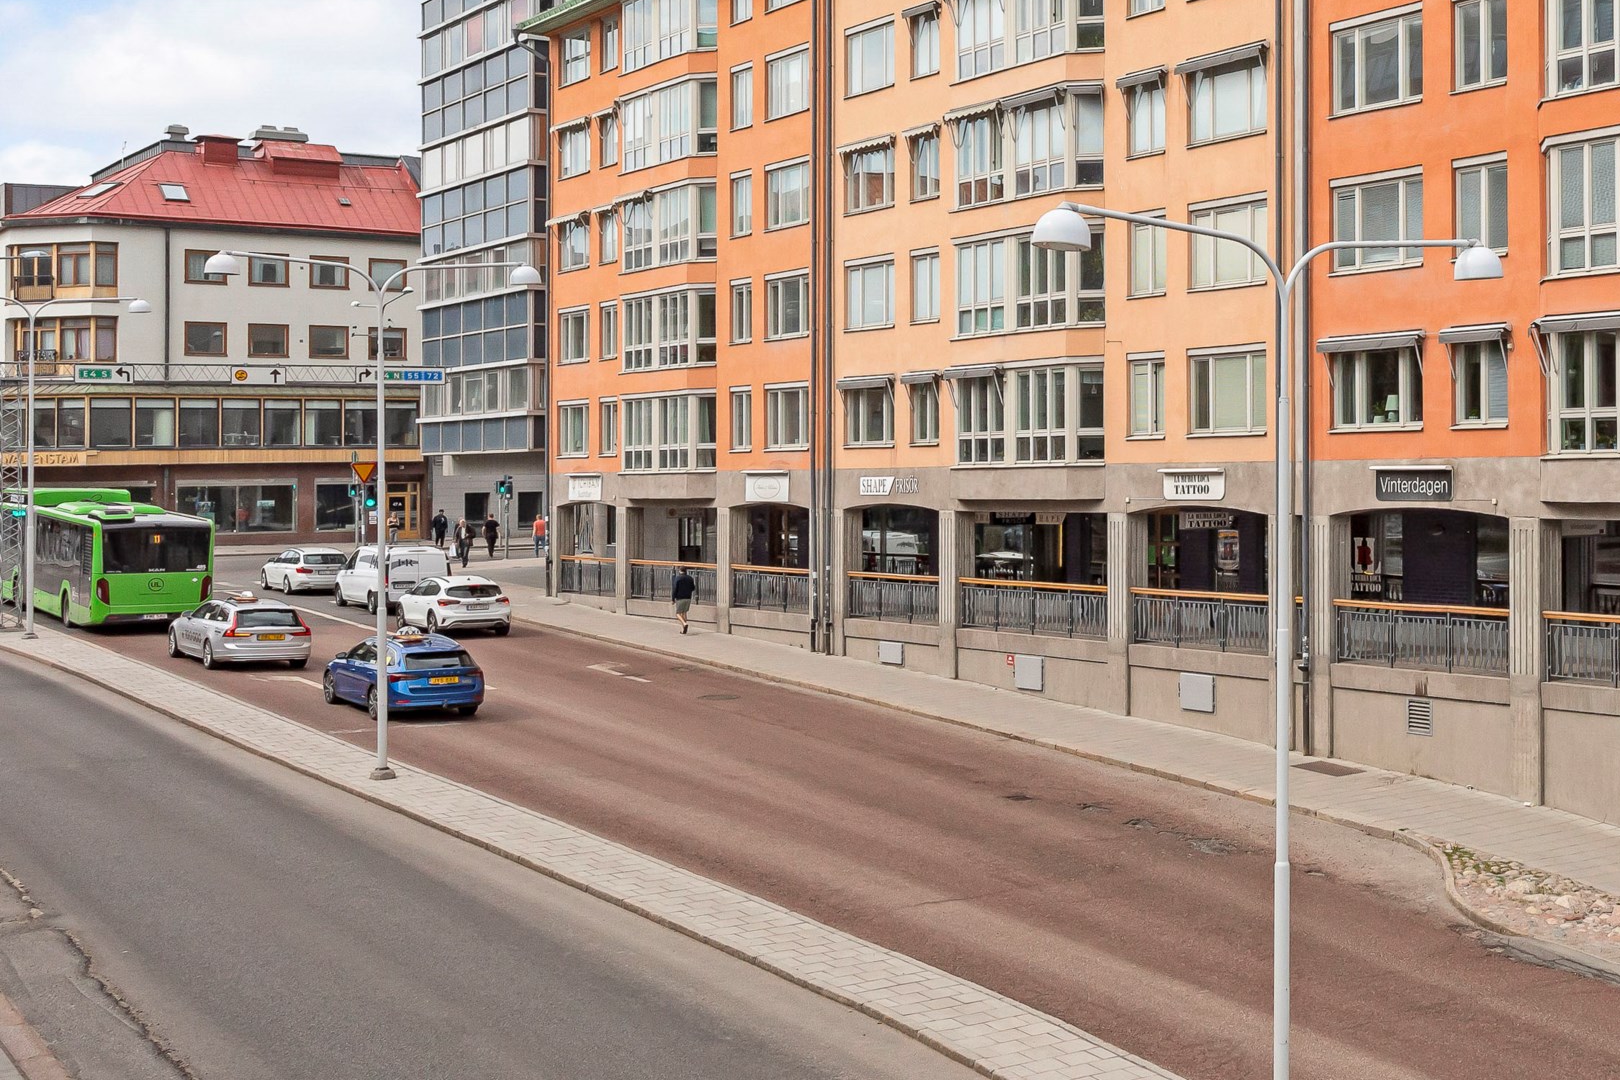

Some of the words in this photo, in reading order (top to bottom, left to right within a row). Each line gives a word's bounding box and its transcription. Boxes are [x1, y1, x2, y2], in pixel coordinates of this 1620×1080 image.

[427, 372, 439, 380] 72
[4, 454, 79, 465] WALENSTAM
[861, 478, 888, 494] SHAPE
[894, 475, 920, 494] FRISÖR
[1173, 484, 1210, 495] TATTOO
[1379, 476, 1448, 496] Vinterdagen
[1187, 520, 1227, 528] TATTOO
